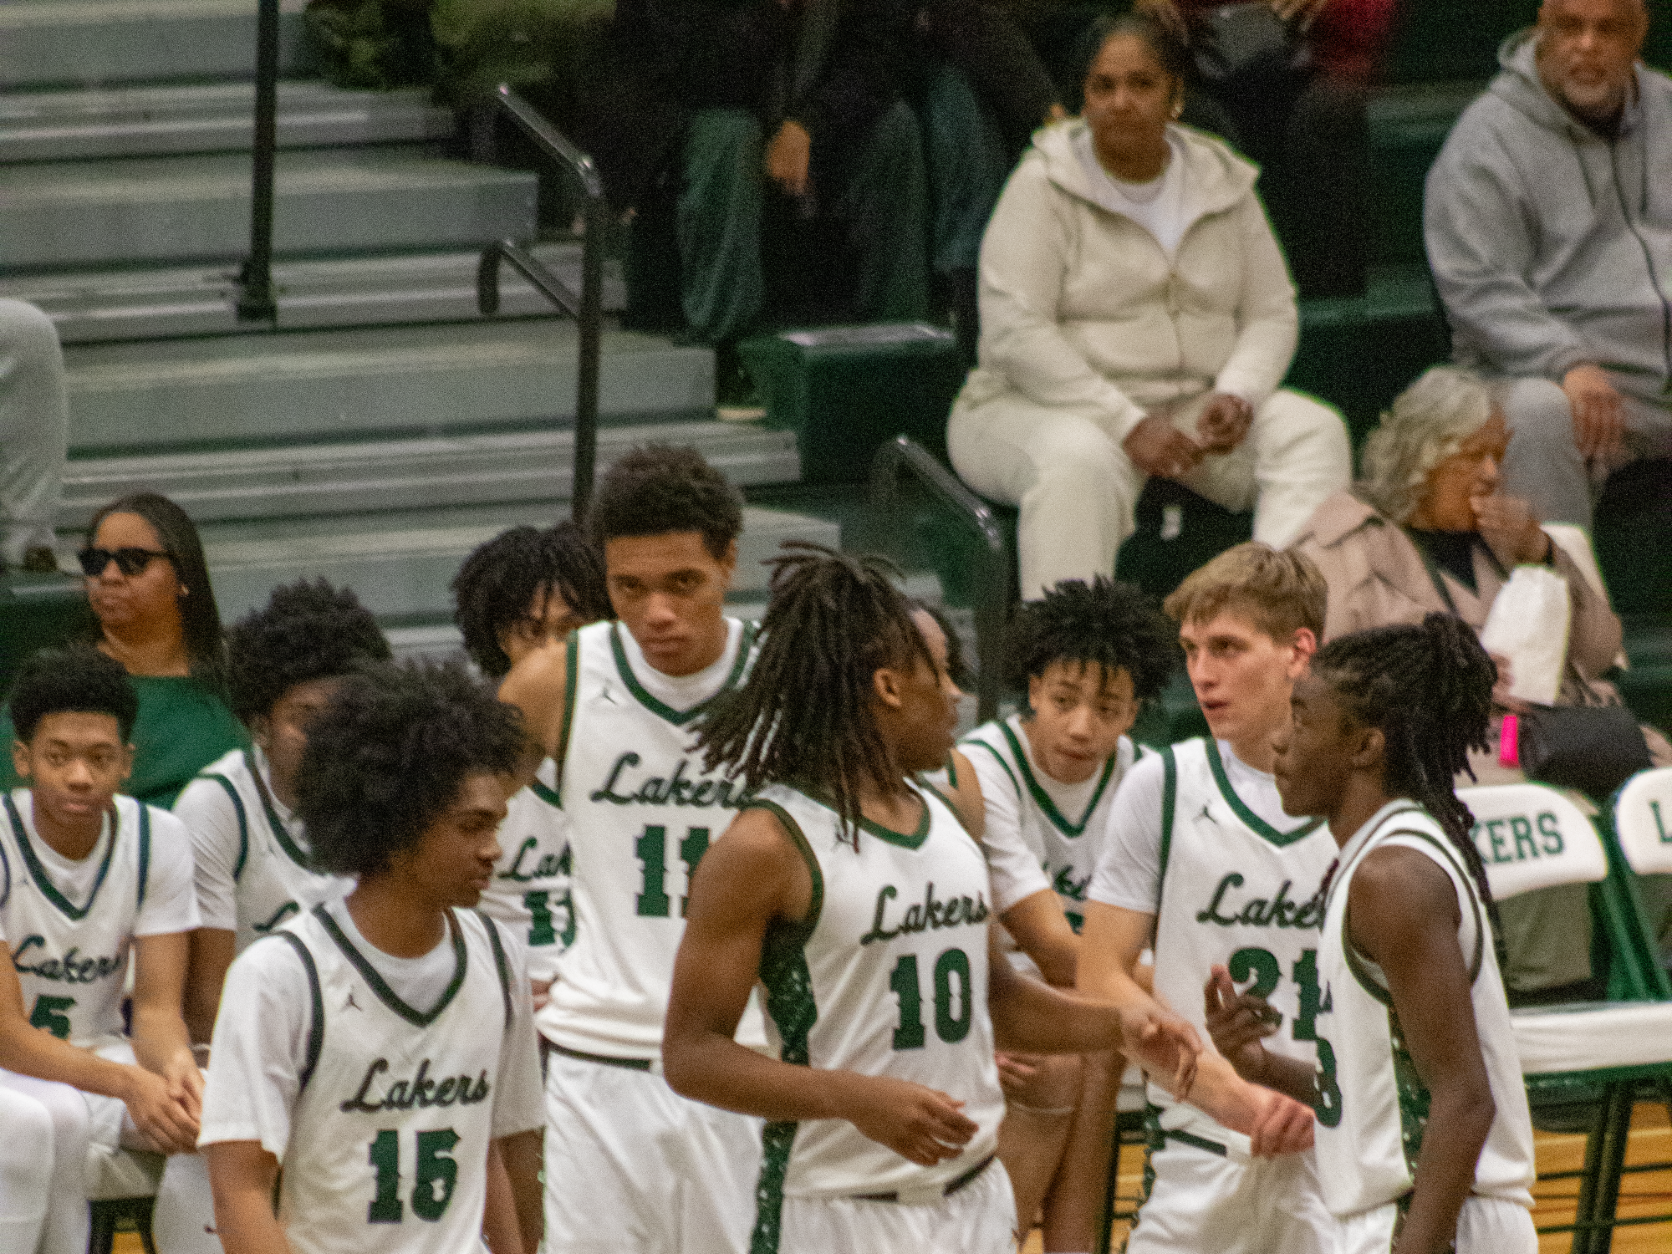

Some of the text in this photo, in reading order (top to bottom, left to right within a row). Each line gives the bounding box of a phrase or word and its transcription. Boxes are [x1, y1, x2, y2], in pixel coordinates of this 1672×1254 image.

[590, 752, 752, 807] Laker
[859, 881, 989, 945] Lakers
[1196, 873, 1327, 930] Lake
[890, 948, 972, 1050] 10
[340, 1058, 490, 1113] Lakers
[367, 1127, 462, 1224] 15
